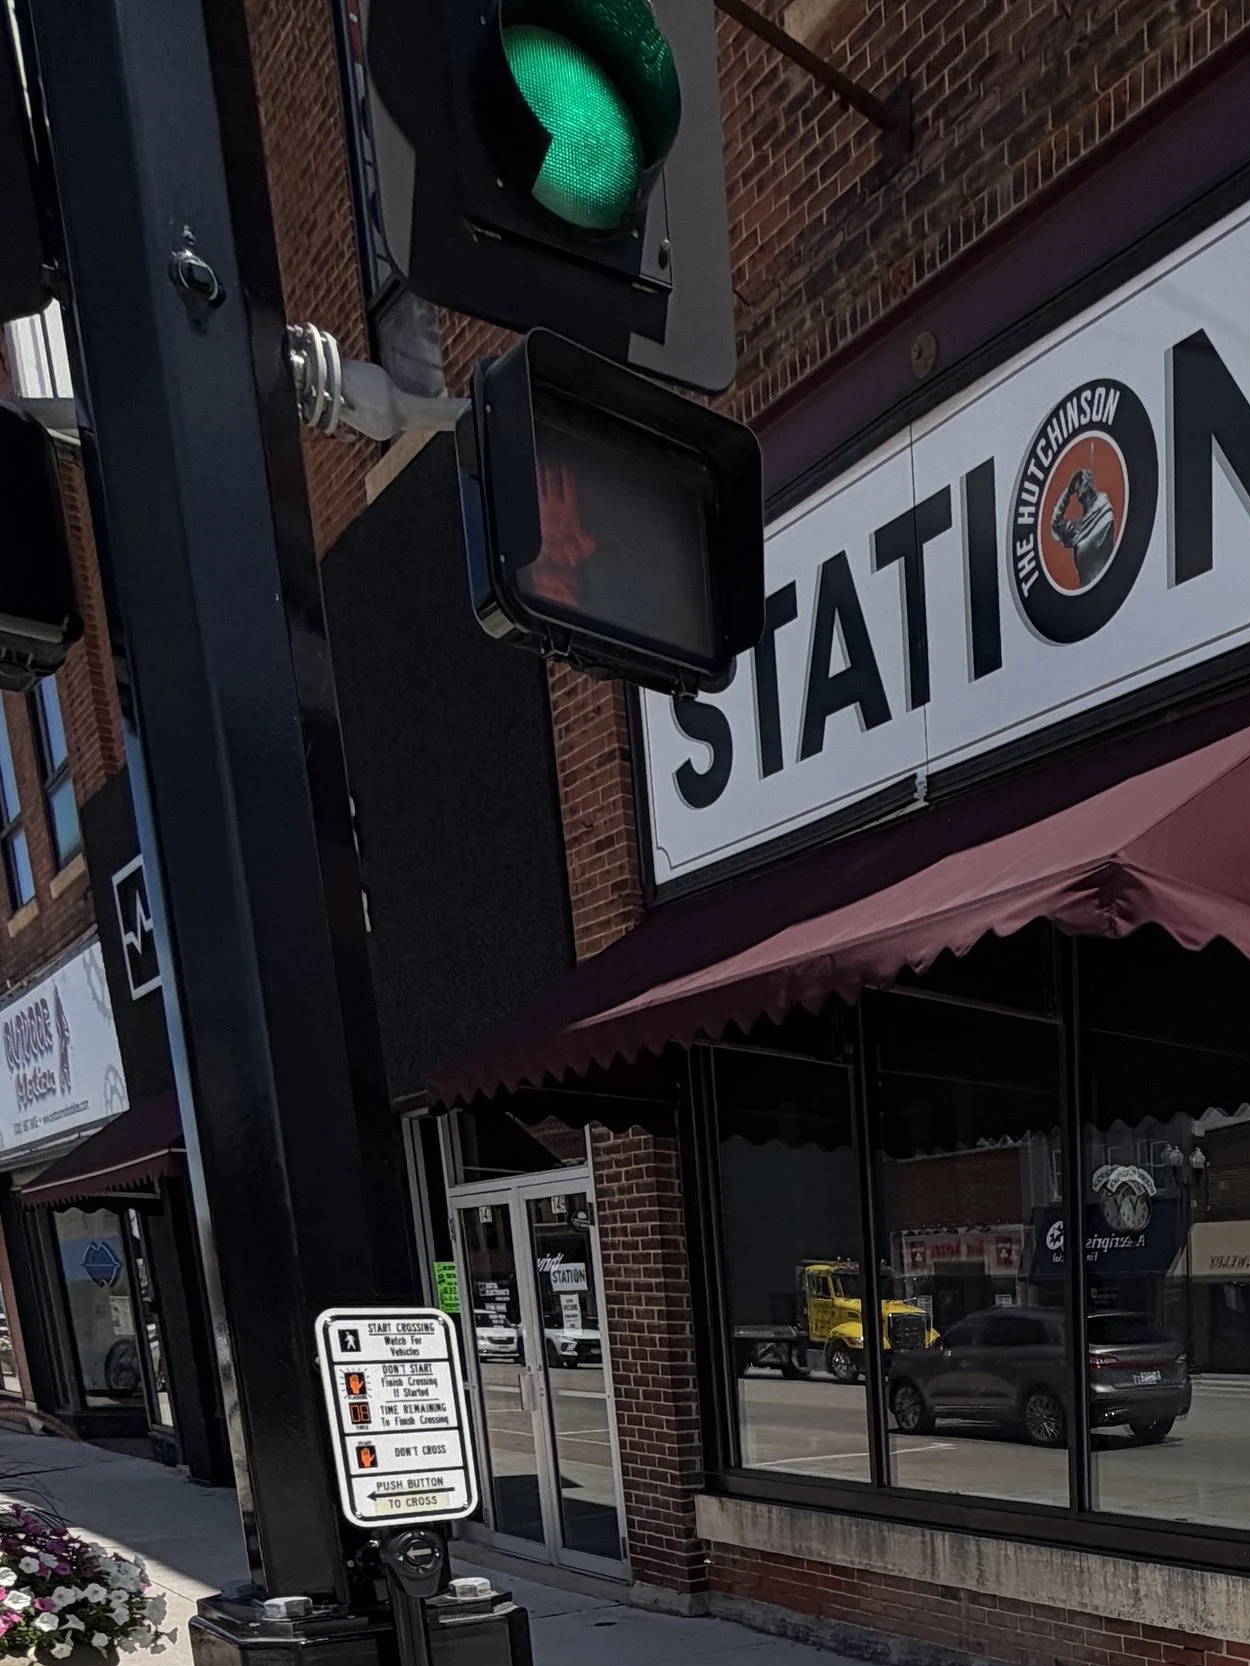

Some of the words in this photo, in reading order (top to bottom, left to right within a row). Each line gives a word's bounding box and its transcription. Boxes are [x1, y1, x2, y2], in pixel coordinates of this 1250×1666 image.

[1017, 387, 1120, 524] HUTCHINSON
[1016, 533, 1040, 598] THE
[552, 1267, 586, 1283] STATION
[368, 1323, 391, 1333] START
[396, 1322, 435, 1332] CROSSING
[384, 1336, 406, 1346] Watch
[411, 1336, 422, 1345] For
[390, 1347, 420, 1356] Vehicles
[382, 1364, 405, 1374] DON'T
[410, 1364, 433, 1373] START
[381, 1378, 403, 1387] Finish
[408, 1377, 438, 1388] Crossing
[403, 1388, 429, 1397] Started
[380, 1405, 399, 1415] TIME
[403, 1403, 447, 1414] REMAINING
[381, 1416, 390, 1427] To
[395, 1416, 415, 1426] Finish
[420, 1415, 449, 1425] Crossing
[395, 1446, 418, 1457] DON'T
[422, 1445, 447, 1455] CROSS
[376, 1480, 403, 1491] PUSH
[407, 1476, 444, 1489] BUTTON
[388, 1499, 401, 1509] TO
[405, 1496, 438, 1507] CROSS
